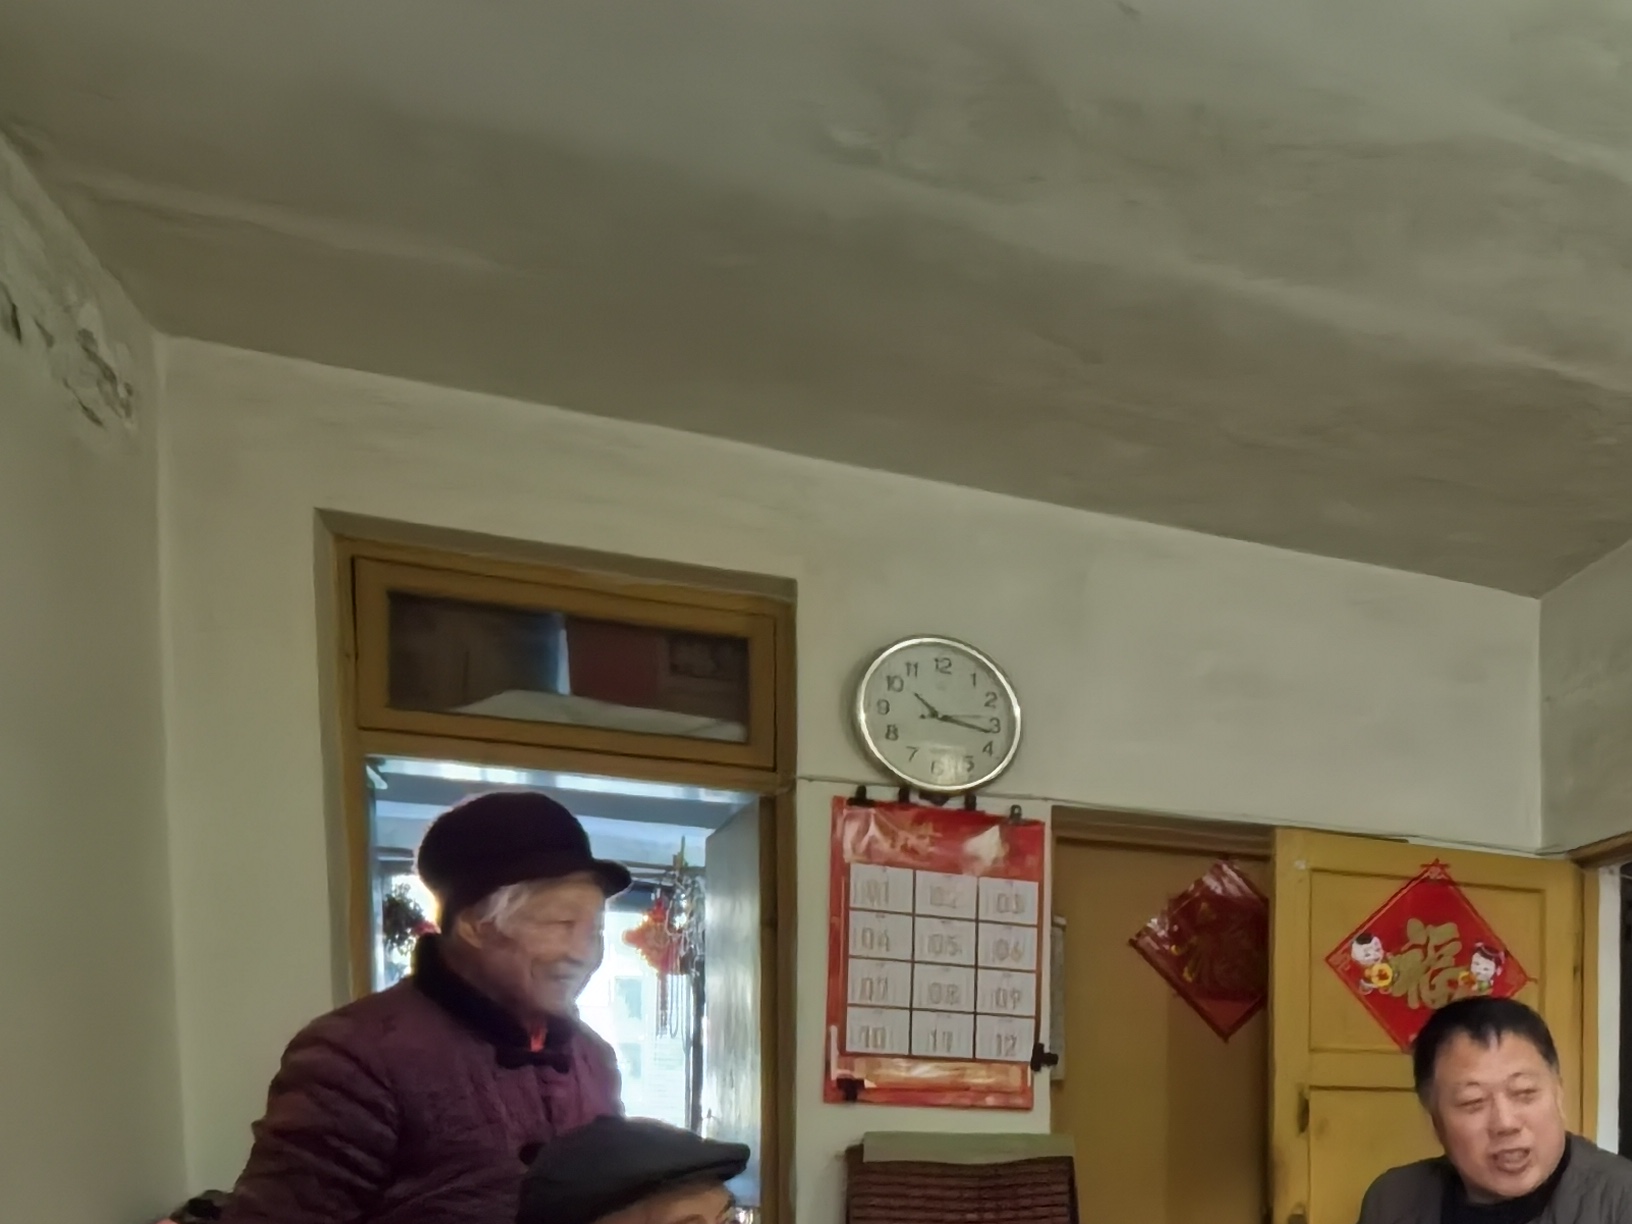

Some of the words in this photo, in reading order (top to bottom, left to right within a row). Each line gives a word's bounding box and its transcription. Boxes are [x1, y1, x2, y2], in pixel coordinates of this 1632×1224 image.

[905, 661, 919, 677] 11
[934, 657, 952, 675] 12
[886, 675, 904, 692] 10
[970, 673, 978, 688] 1
[877, 699, 890, 715] 9
[984, 691, 999, 709] 2
[885, 724, 899, 741] 8
[989, 717, 1001, 734] 3
[906, 746, 920, 762] 7
[982, 741, 993, 757] 4
[1388, 918, 1468, 1010] 福
